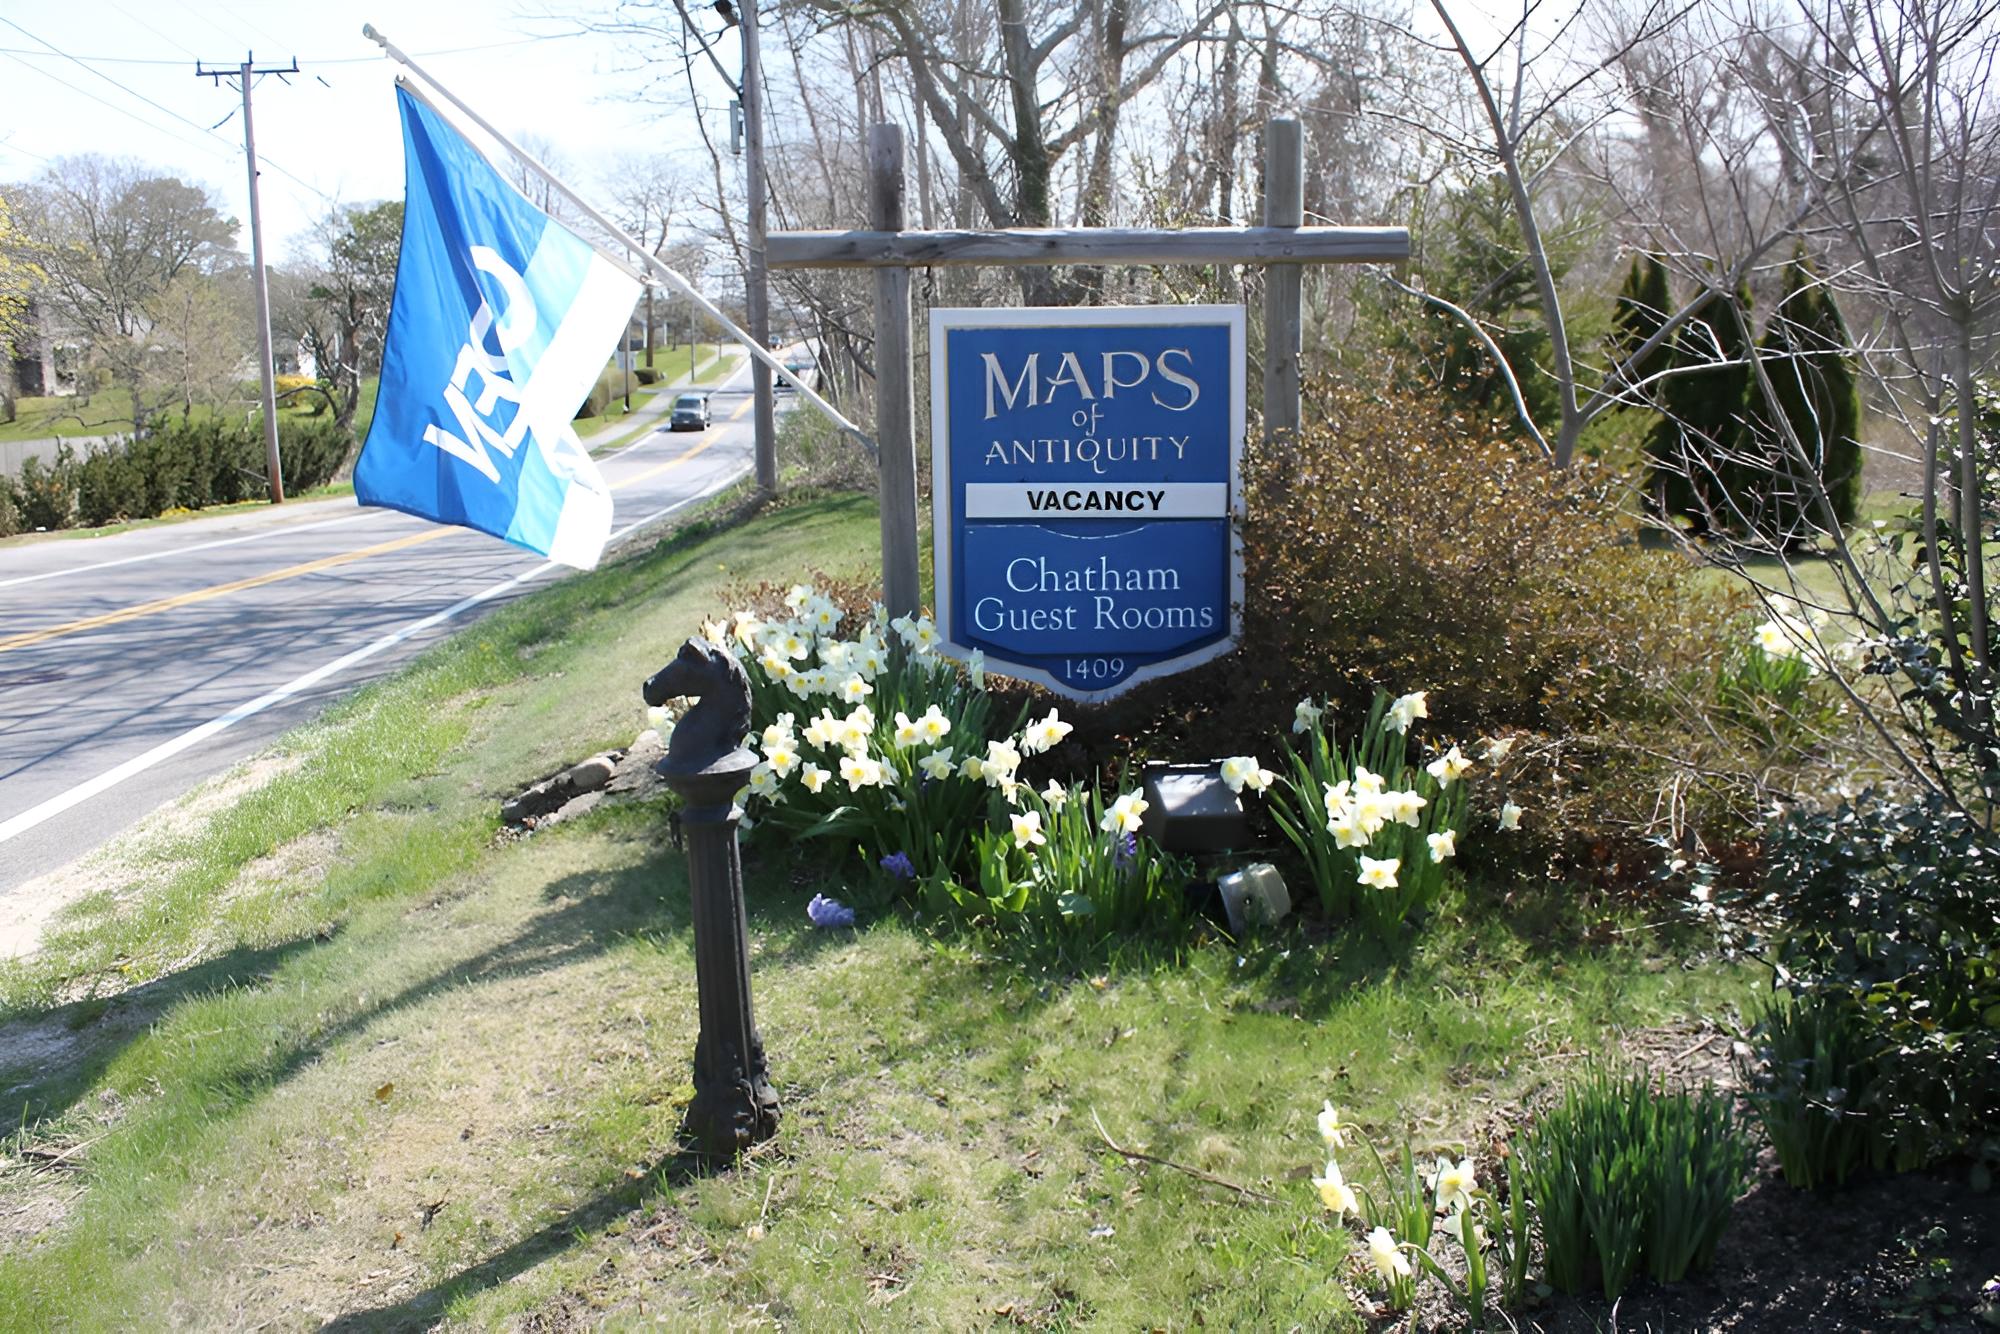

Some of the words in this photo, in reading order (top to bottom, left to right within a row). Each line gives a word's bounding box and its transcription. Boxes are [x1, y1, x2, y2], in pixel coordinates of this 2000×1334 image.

[980, 349, 1200, 420] MAPS
[1071, 402, 1105, 436] of
[984, 436, 1190, 474] ANTIQUITY
[1026, 490, 1166, 512] VACANCY
[1006, 556, 1180, 593] Chatham
[974, 596, 1077, 632] Guest
[1093, 595, 1214, 630] Rooms
[1064, 657, 1125, 680] 1409
